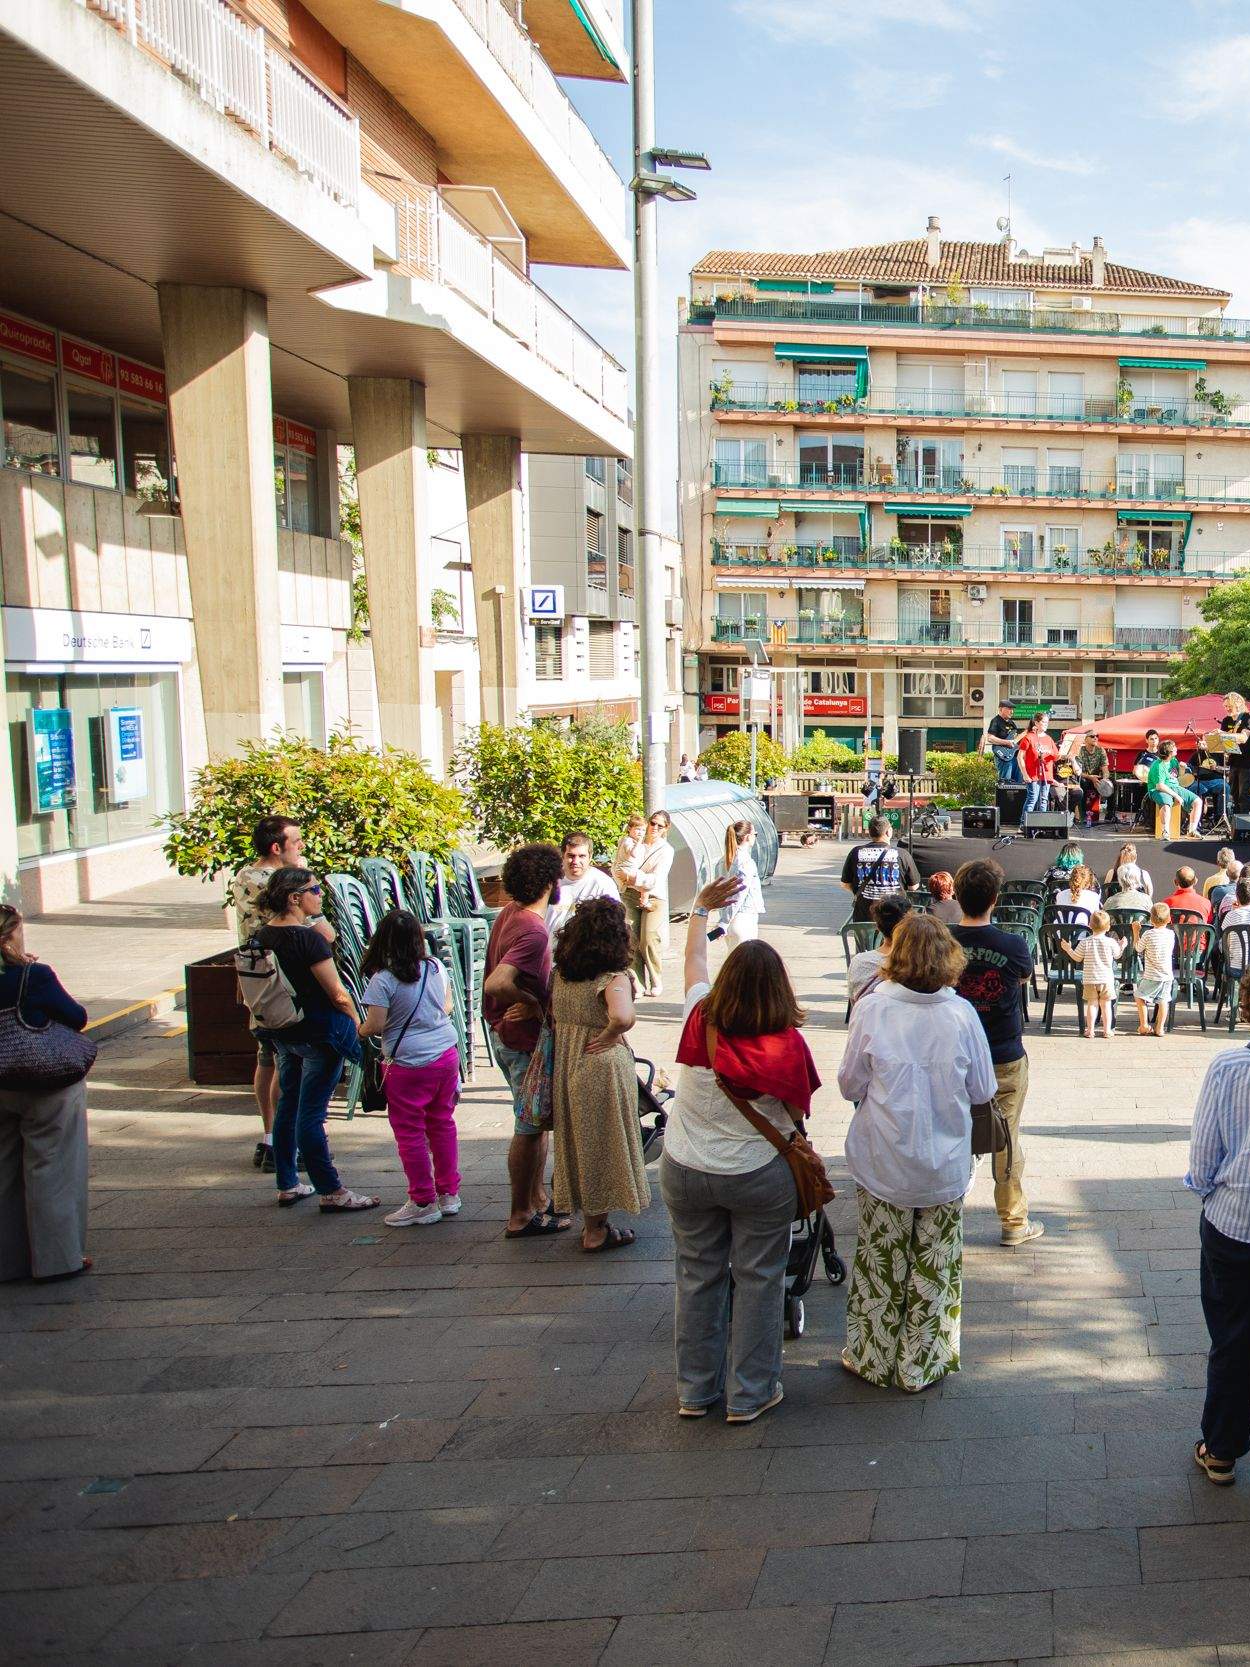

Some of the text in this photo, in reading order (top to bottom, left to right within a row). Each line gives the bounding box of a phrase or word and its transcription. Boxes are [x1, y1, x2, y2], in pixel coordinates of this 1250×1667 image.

[72, 349, 92, 366] Qgat
[120, 369, 129, 382] 93
[63, 633, 109, 648] Deutsche
[813, 699, 848, 708] Catalunya
